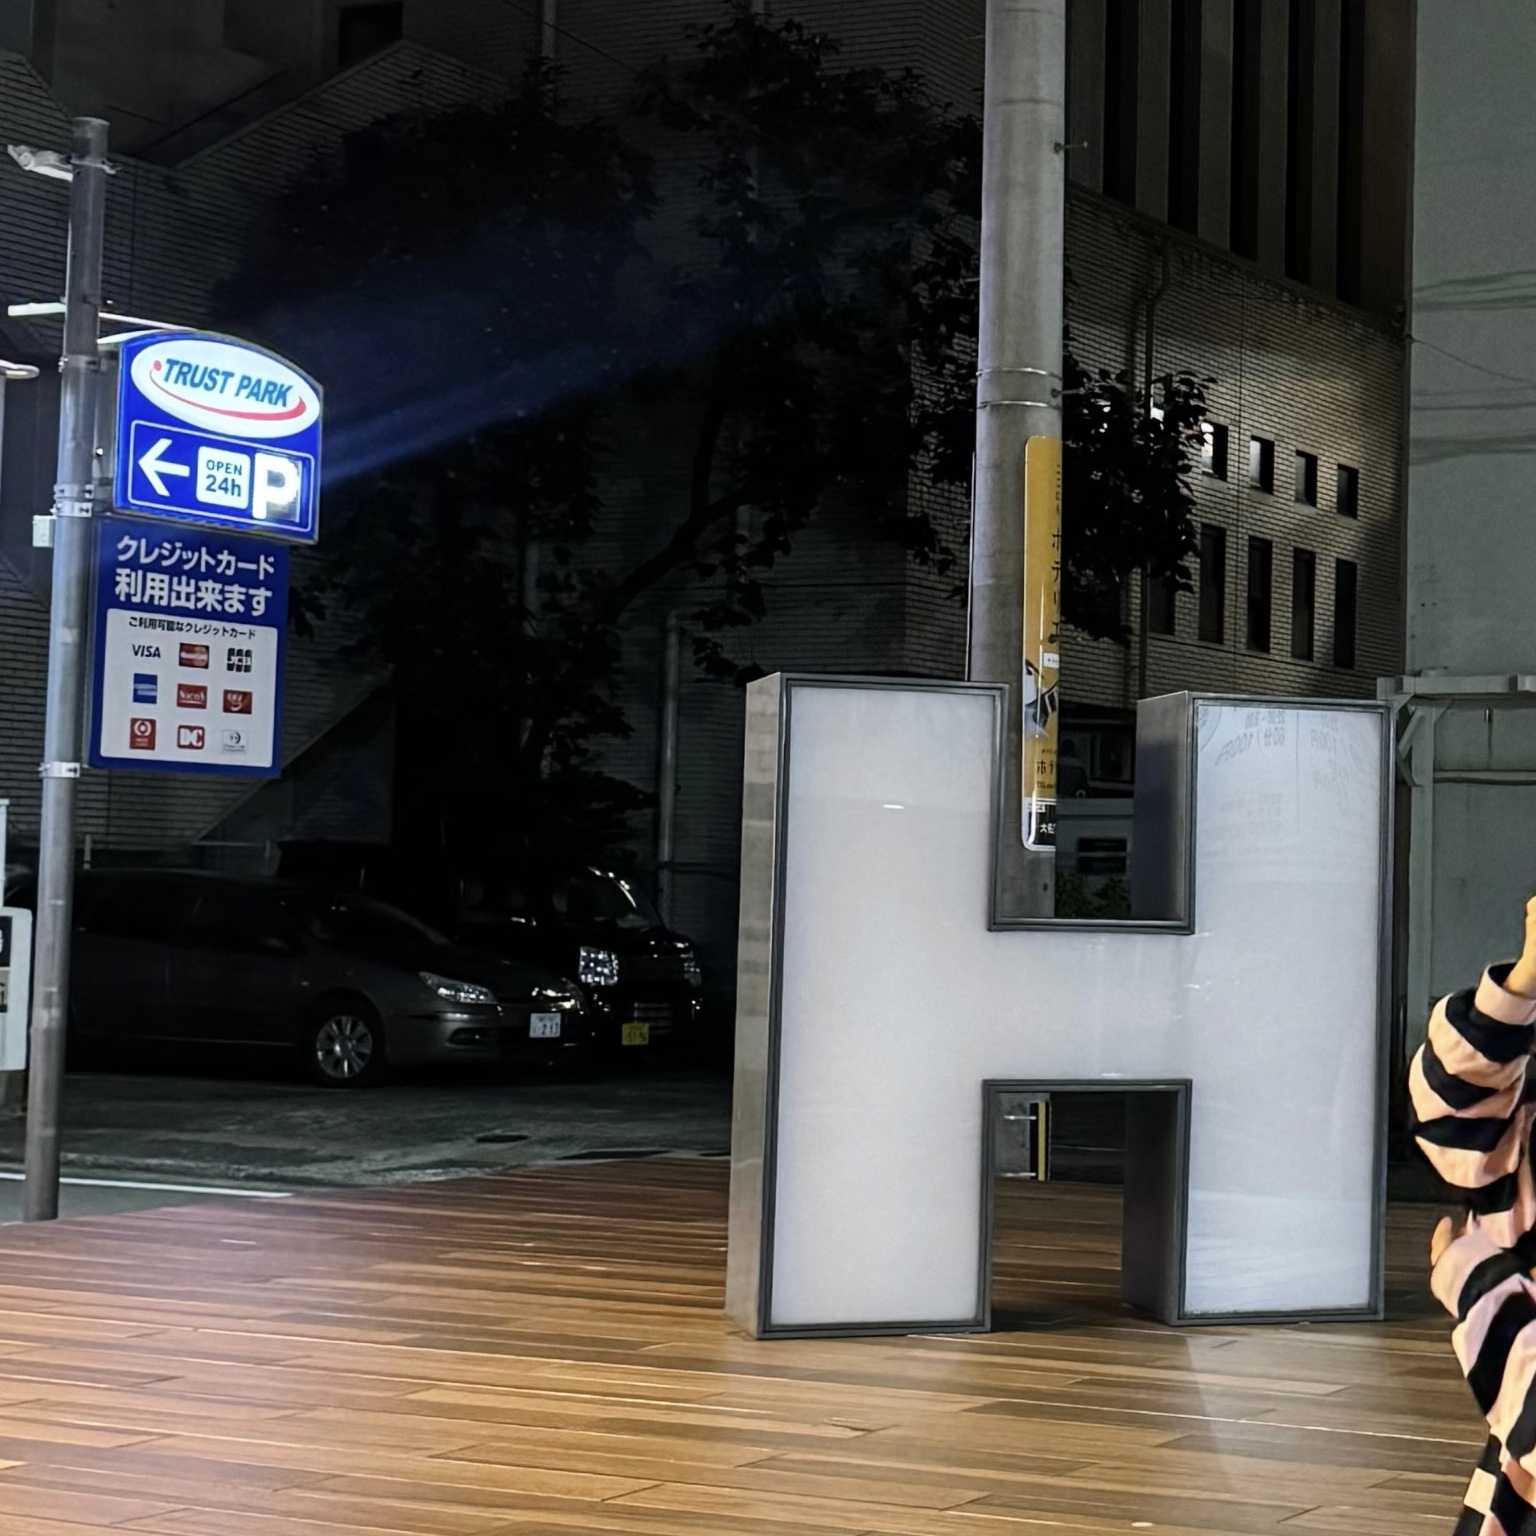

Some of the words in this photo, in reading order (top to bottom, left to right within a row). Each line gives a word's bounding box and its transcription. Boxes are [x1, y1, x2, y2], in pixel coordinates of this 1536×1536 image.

[163, 358, 234, 395] TRUST
[235, 374, 293, 407] PARK
[205, 474, 242, 497] 24h
[206, 459, 243, 476] OPEN
[252, 452, 299, 520] P
[117, 534, 275, 580] クレジットカード
[115, 567, 273, 617] 利用出来ます
[132, 644, 161, 659] VISA
[179, 728, 203, 747] DC
[755, 673, 1391, 1340] H
